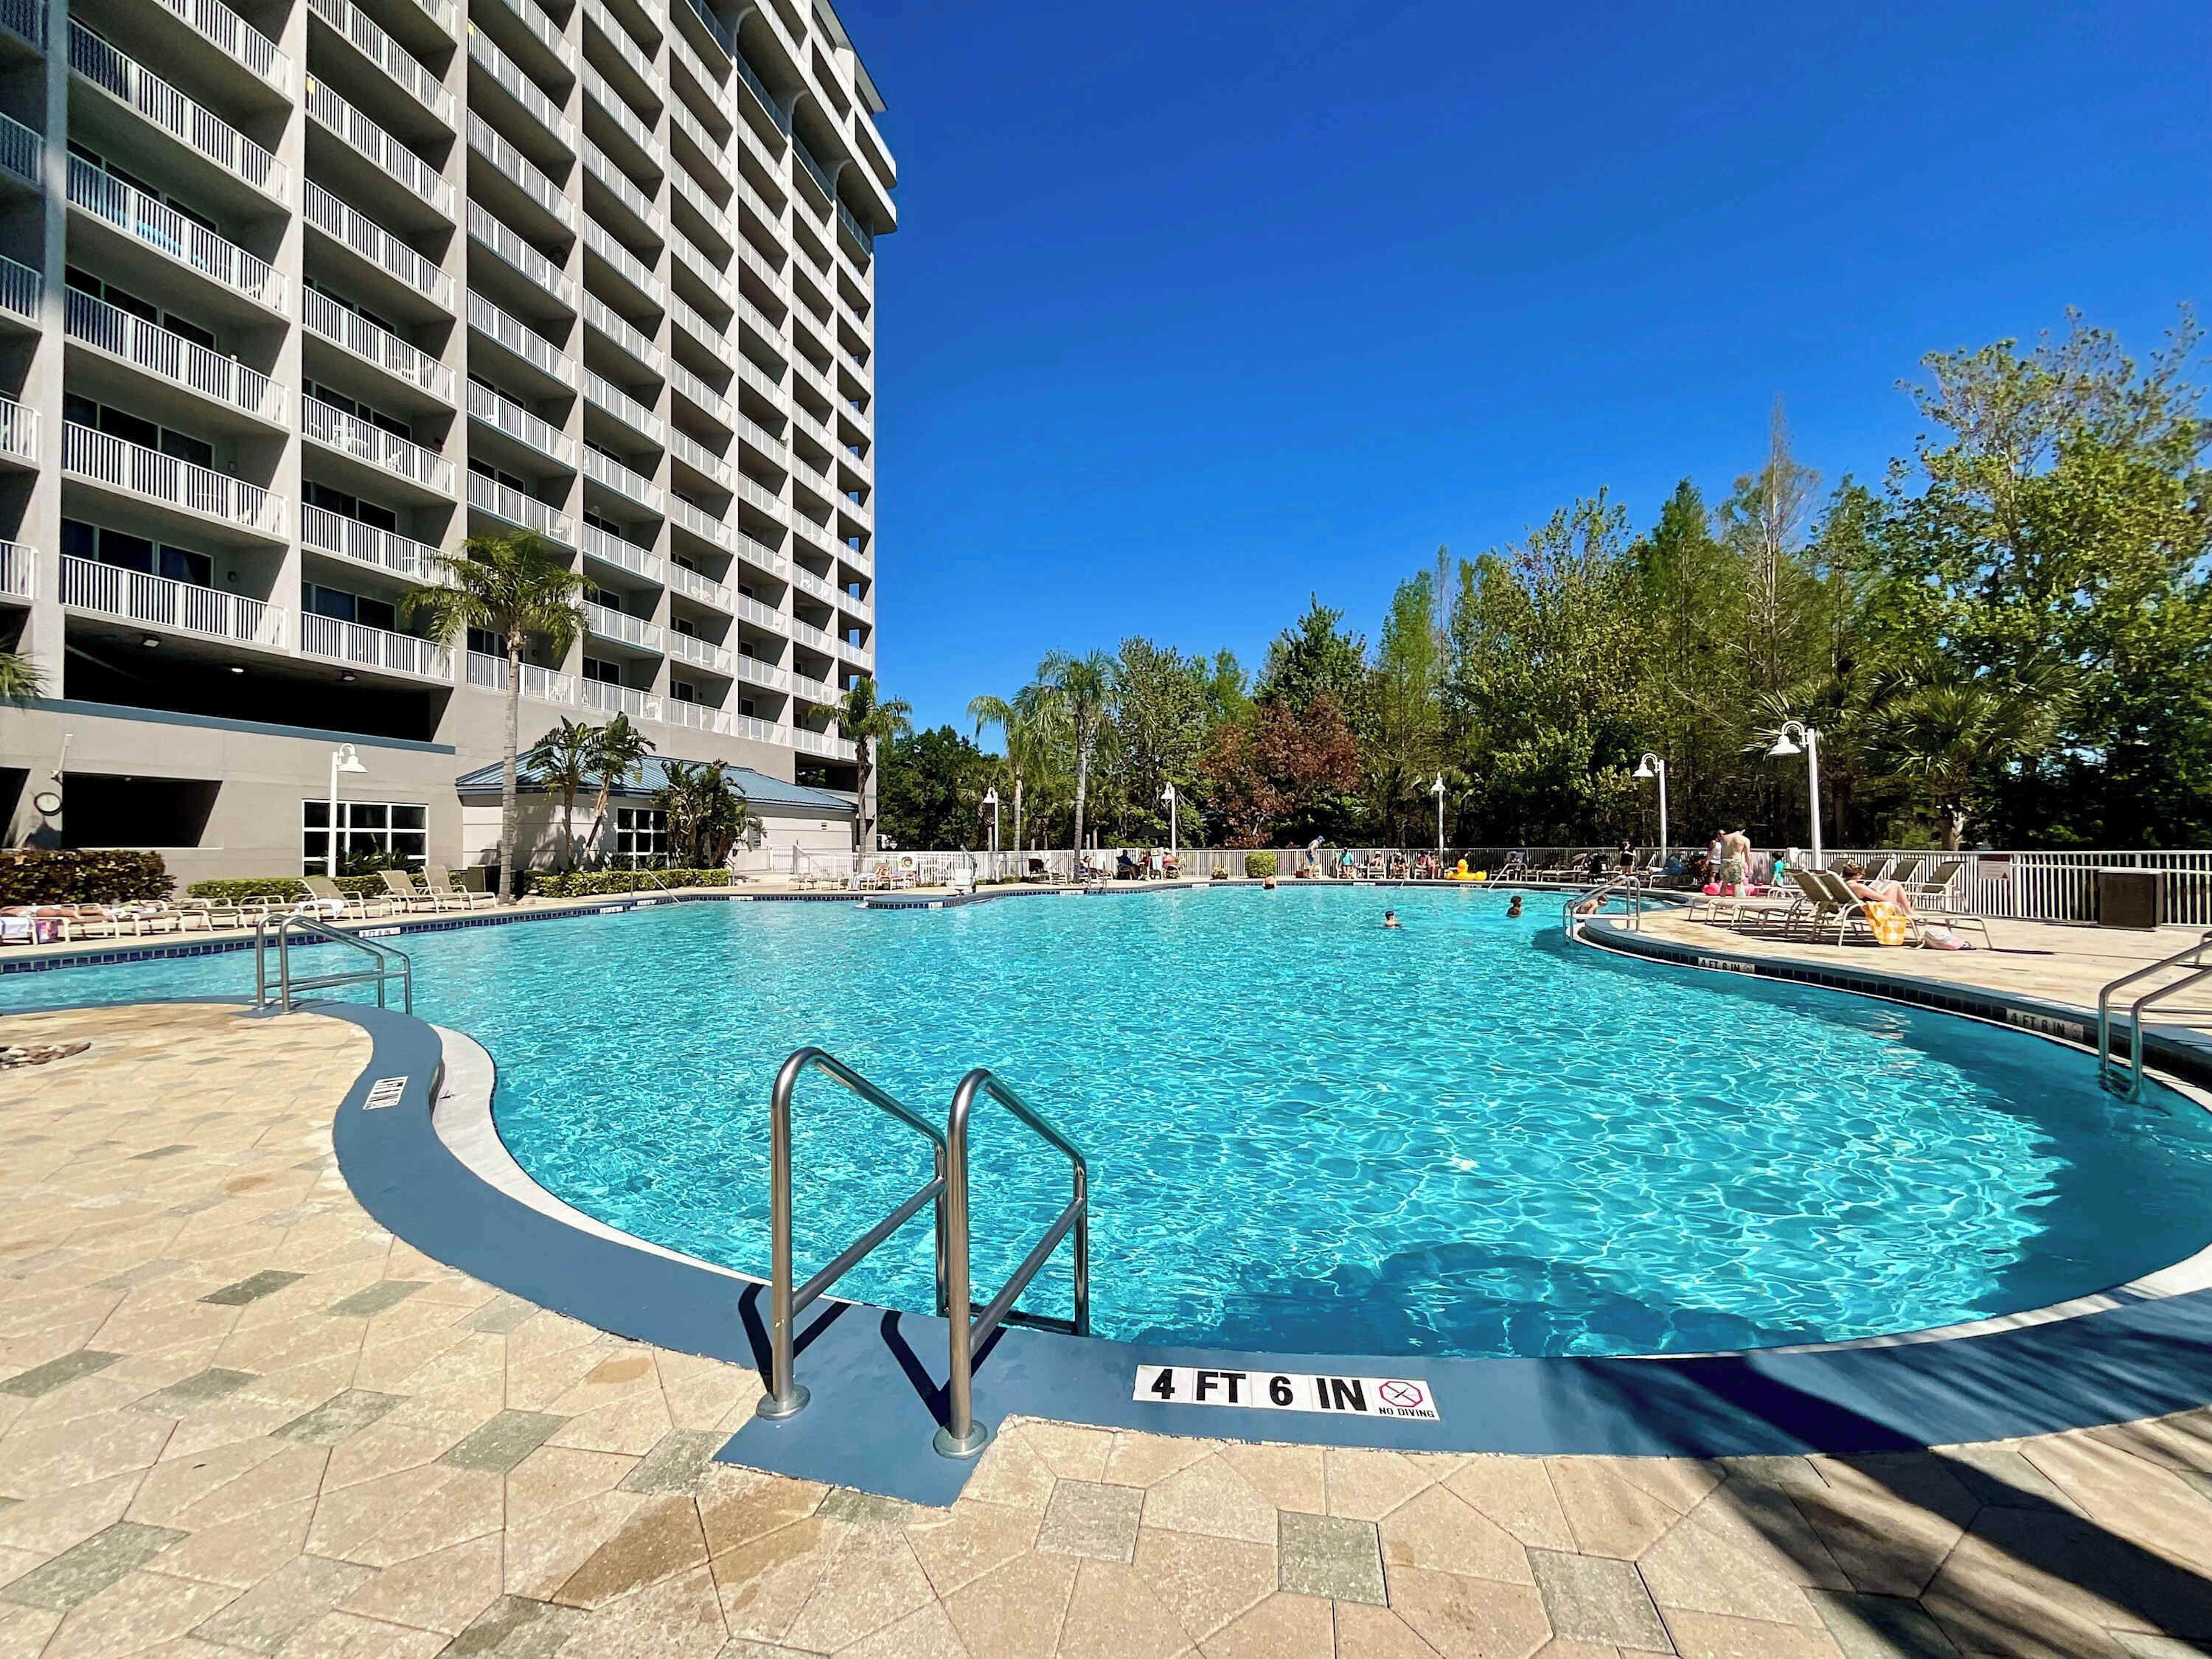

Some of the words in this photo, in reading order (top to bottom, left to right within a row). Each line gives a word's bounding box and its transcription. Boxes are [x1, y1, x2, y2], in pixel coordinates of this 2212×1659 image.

[1709, 960, 1719, 968] FT
[1731, 964, 1740, 972] IN
[2011, 1013, 2017, 1023] 4
[2023, 1015, 2035, 1028] FT
[2053, 1022, 2065, 1036] IN
[1151, 1369, 1175, 1399] 4
[1197, 1371, 1246, 1403] FT
[1269, 1376, 1293, 1406] 6
[1316, 1377, 1368, 1411] IN
[1379, 1407, 1395, 1416] NO
[1397, 1409, 1435, 1419] DIVING
